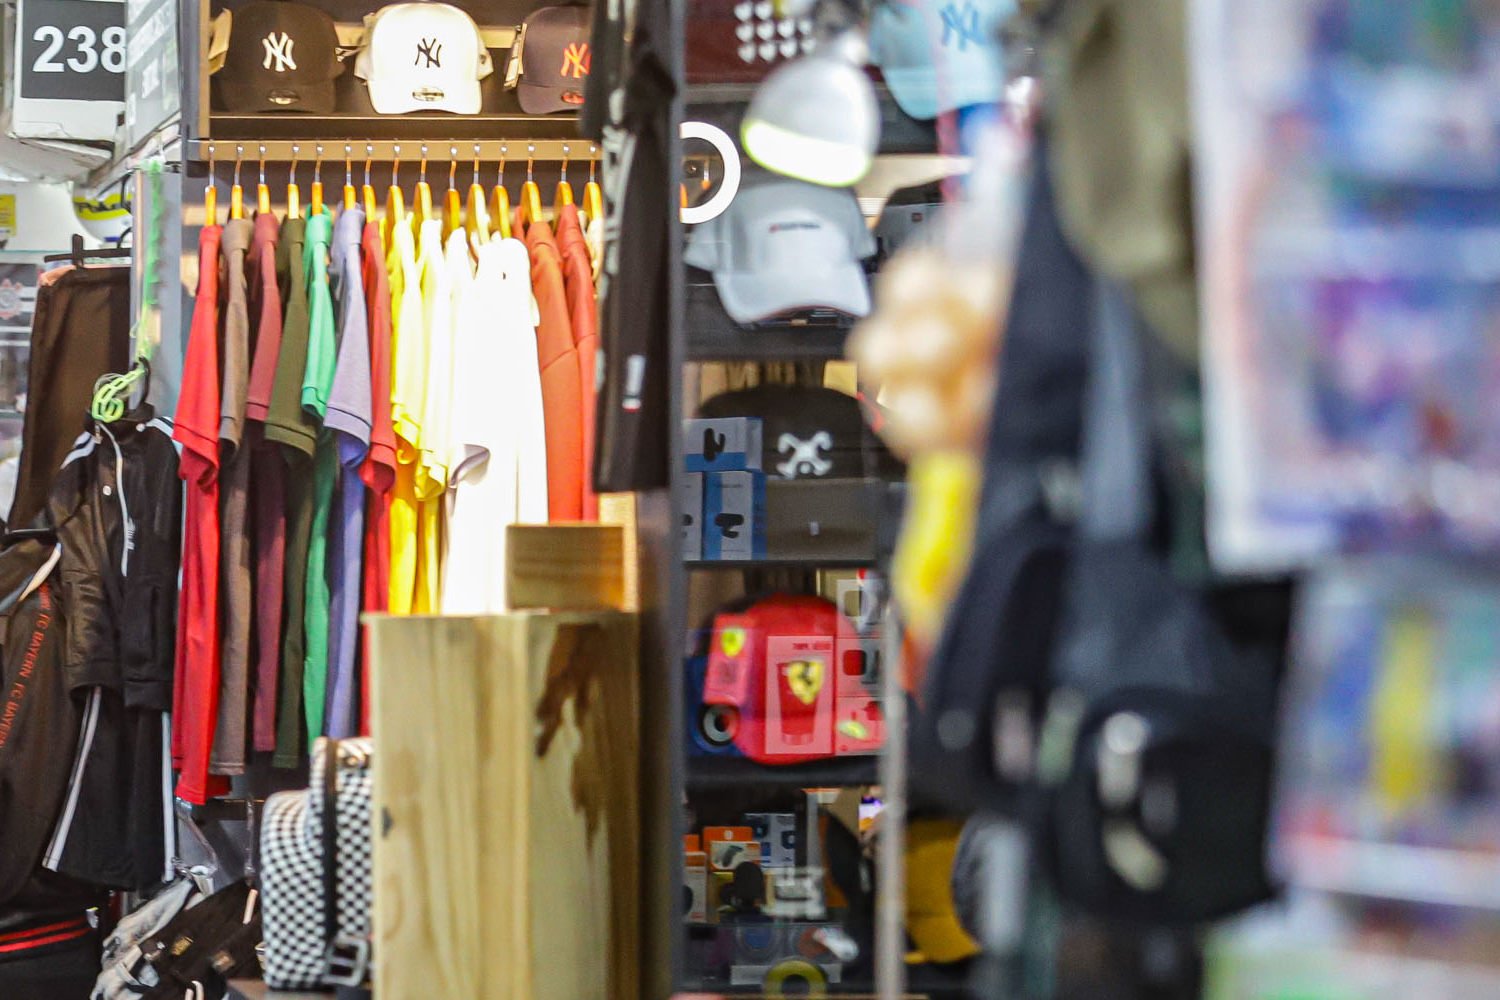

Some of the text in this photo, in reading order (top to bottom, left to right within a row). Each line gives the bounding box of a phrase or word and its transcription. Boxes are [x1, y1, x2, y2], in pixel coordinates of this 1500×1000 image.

[33, 25, 127, 74] 238
[262, 32, 297, 72] NY
[415, 38, 442, 68] NY
